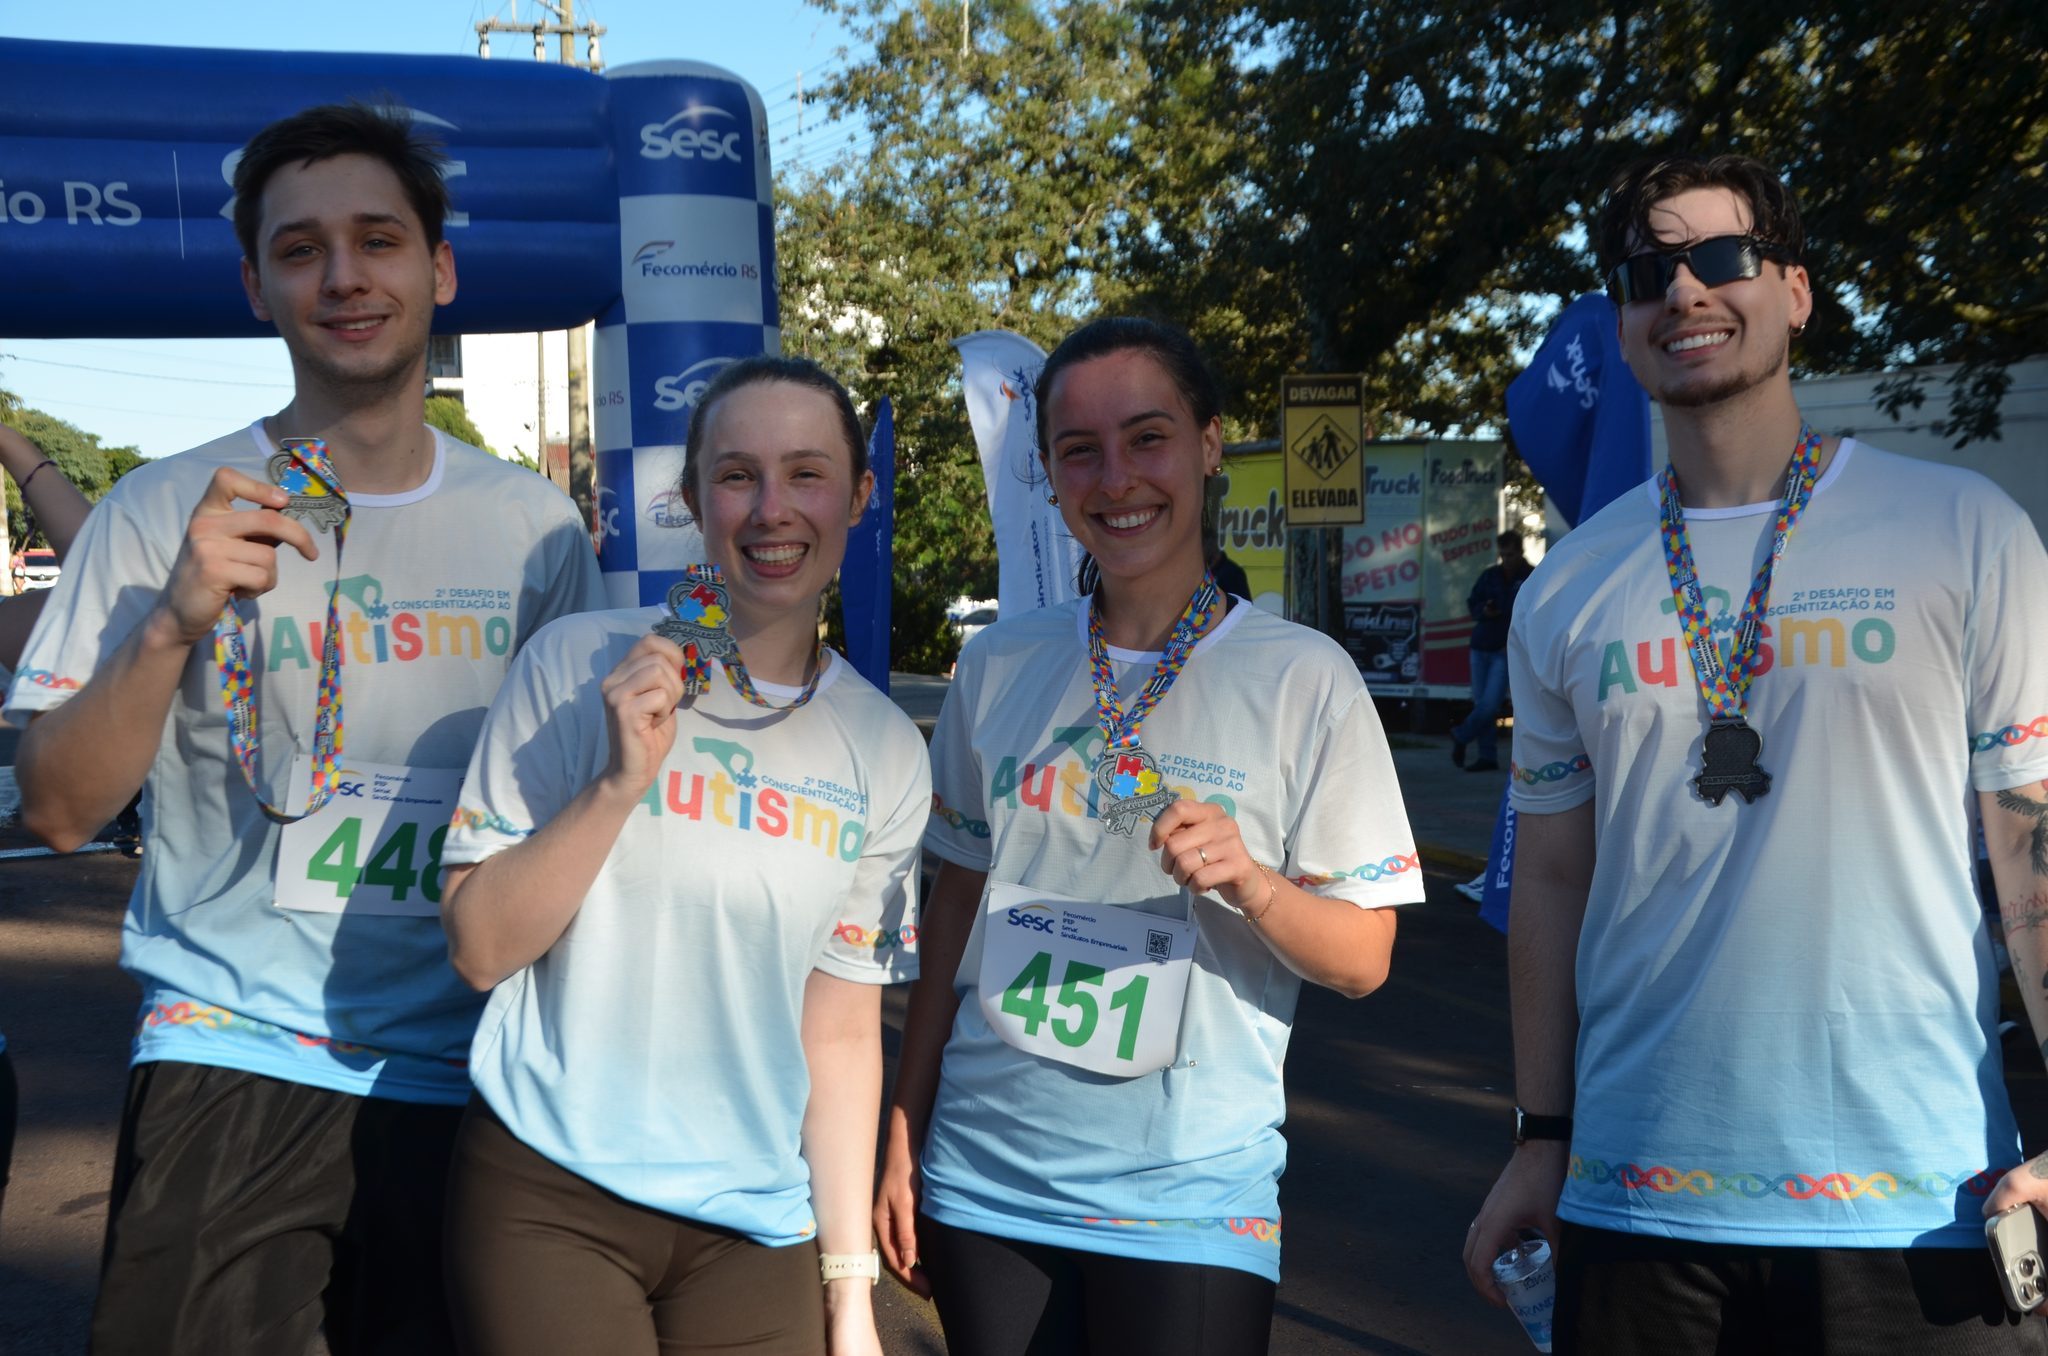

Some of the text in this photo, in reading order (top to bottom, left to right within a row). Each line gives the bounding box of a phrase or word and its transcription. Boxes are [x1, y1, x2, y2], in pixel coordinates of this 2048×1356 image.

[639, 123, 741, 163] Sesc
[64, 181, 141, 226] RS
[642, 261, 758, 280] Fecomércio RS
[1289, 386, 1357, 401] DEVAGAR
[1292, 487, 1359, 509] ELEVADA
[1382, 523, 1423, 552] NO
[1430, 524, 1470, 546] TUDO
[1442, 538, 1492, 563] ESPETO
[392, 598, 511, 610] CONSCIENTIZAÇÃO AO
[449, 588, 494, 598] DESAFIO
[497, 590, 510, 599] EM
[1809, 588, 1870, 600] DESAFIO
[1875, 588, 1895, 598] EM
[1874, 600, 1895, 611] AO
[267, 611, 510, 672] Autismo
[1174, 755, 1227, 775] DESAFIO
[1229, 768, 1247, 781] EM
[761, 775, 857, 812] CONSCIENTIZAÇÃO
[818, 779, 859, 802] DESAFIO
[1226, 780, 1245, 792] AO
[1007, 908, 1055, 935] Sesc
[1000, 951, 1149, 1061] 451
